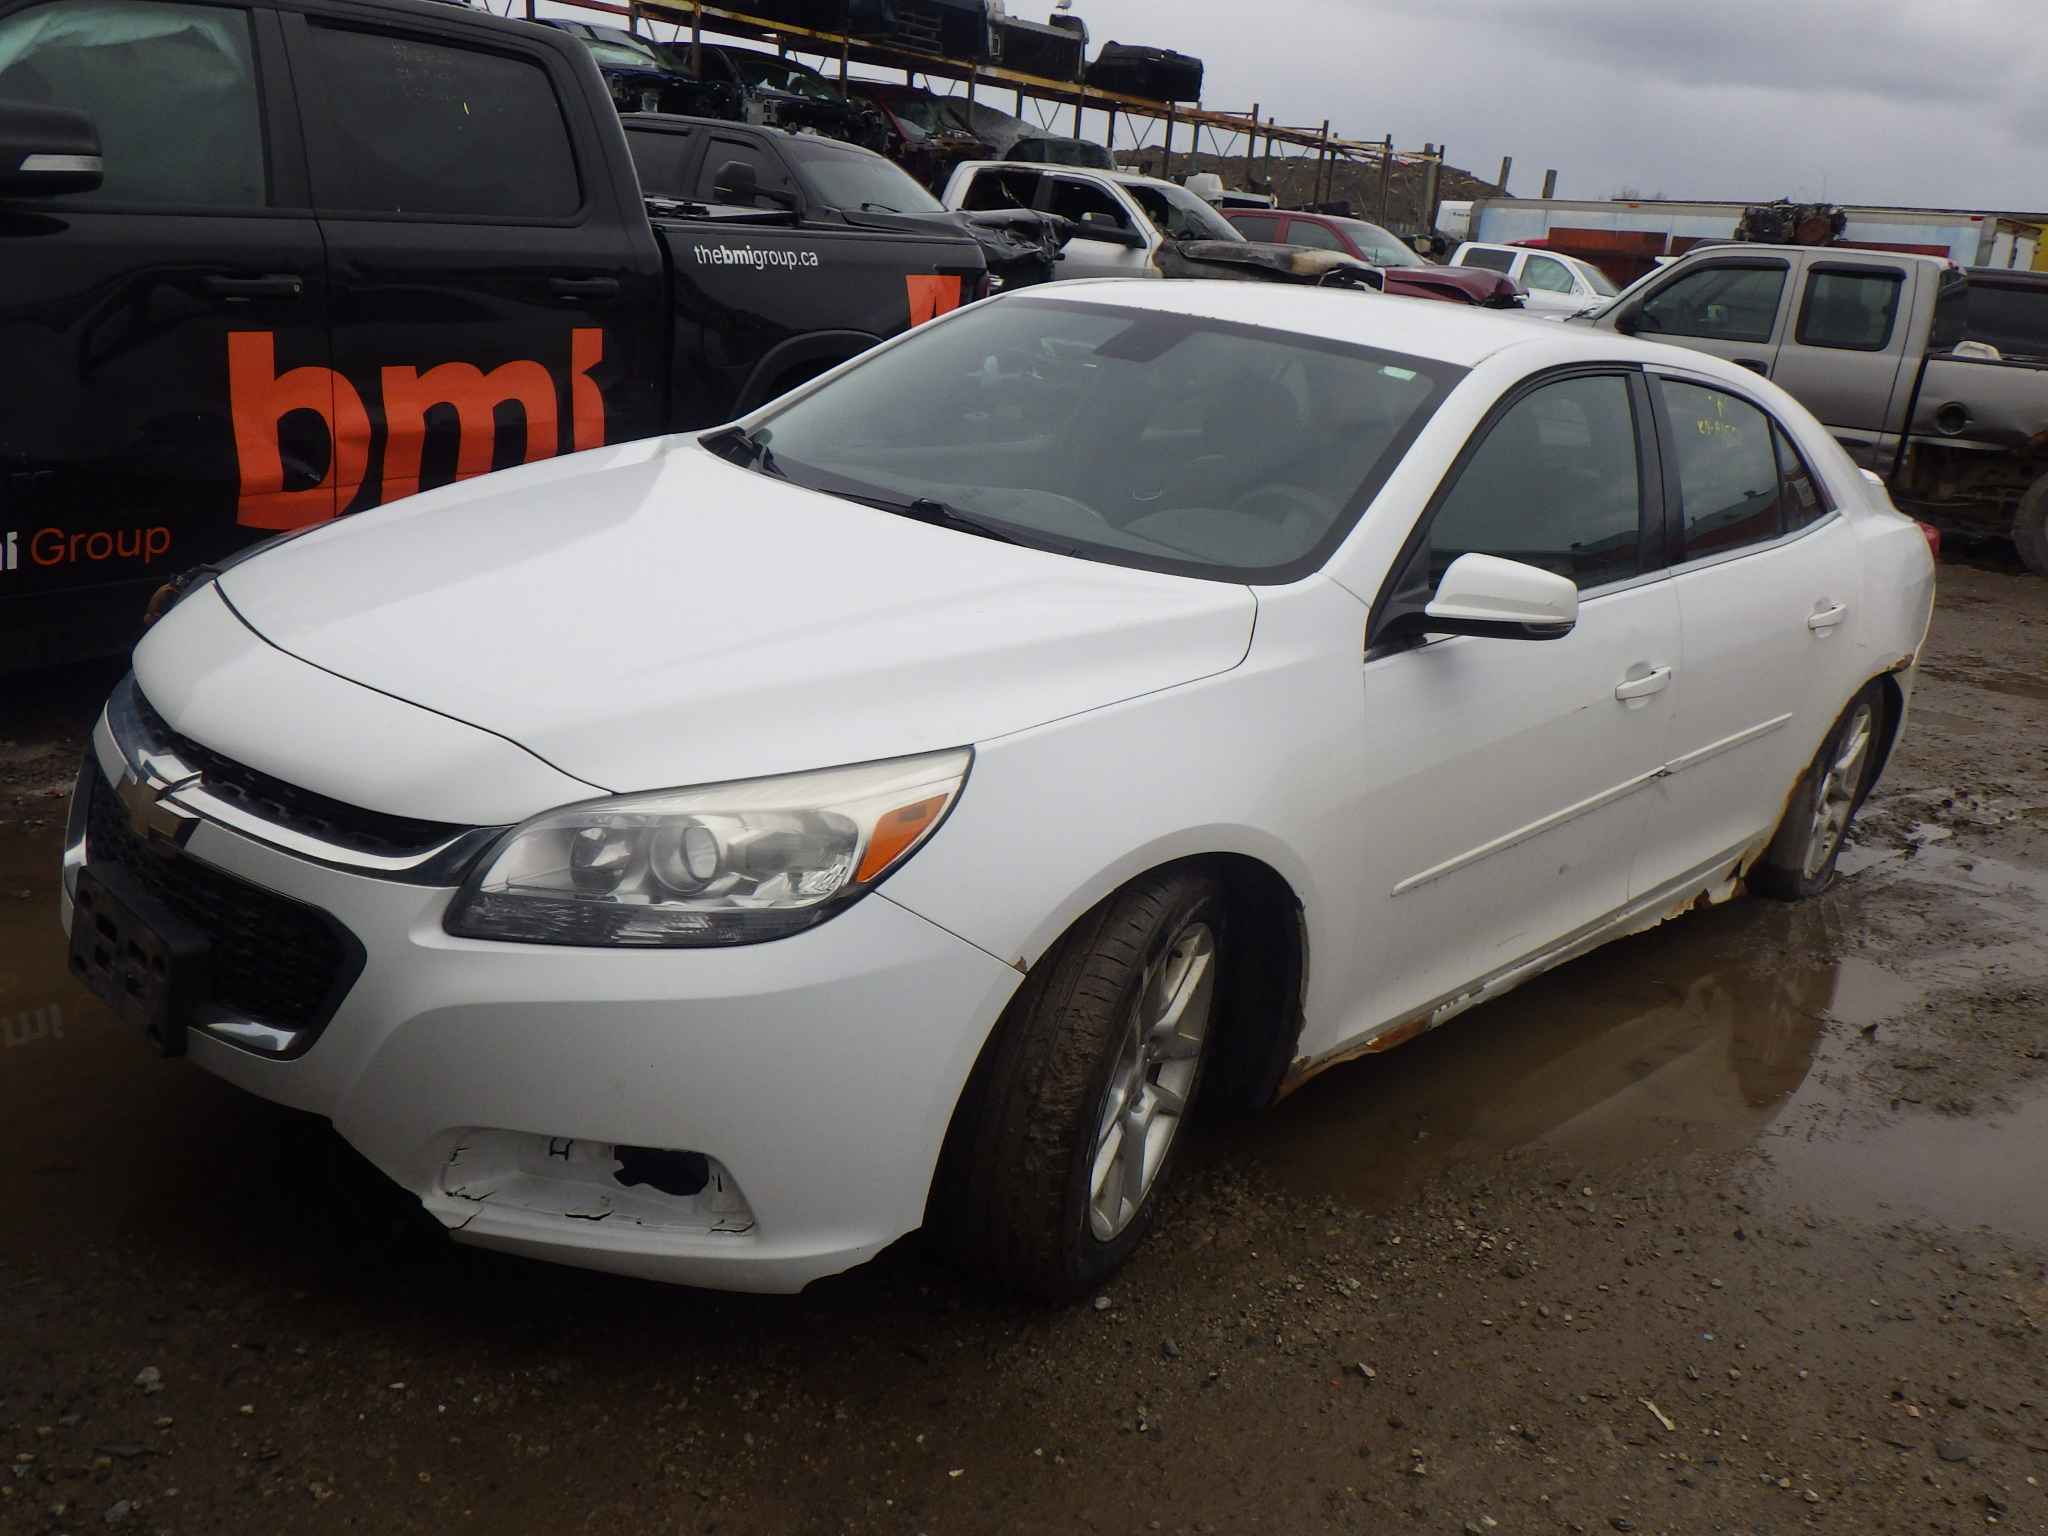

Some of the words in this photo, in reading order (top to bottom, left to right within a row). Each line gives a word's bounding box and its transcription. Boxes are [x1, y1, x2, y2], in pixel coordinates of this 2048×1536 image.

[694, 244, 818, 270] thebmigroup.ca
[227, 328, 606, 534] bmi
[31, 527, 172, 566] Group
